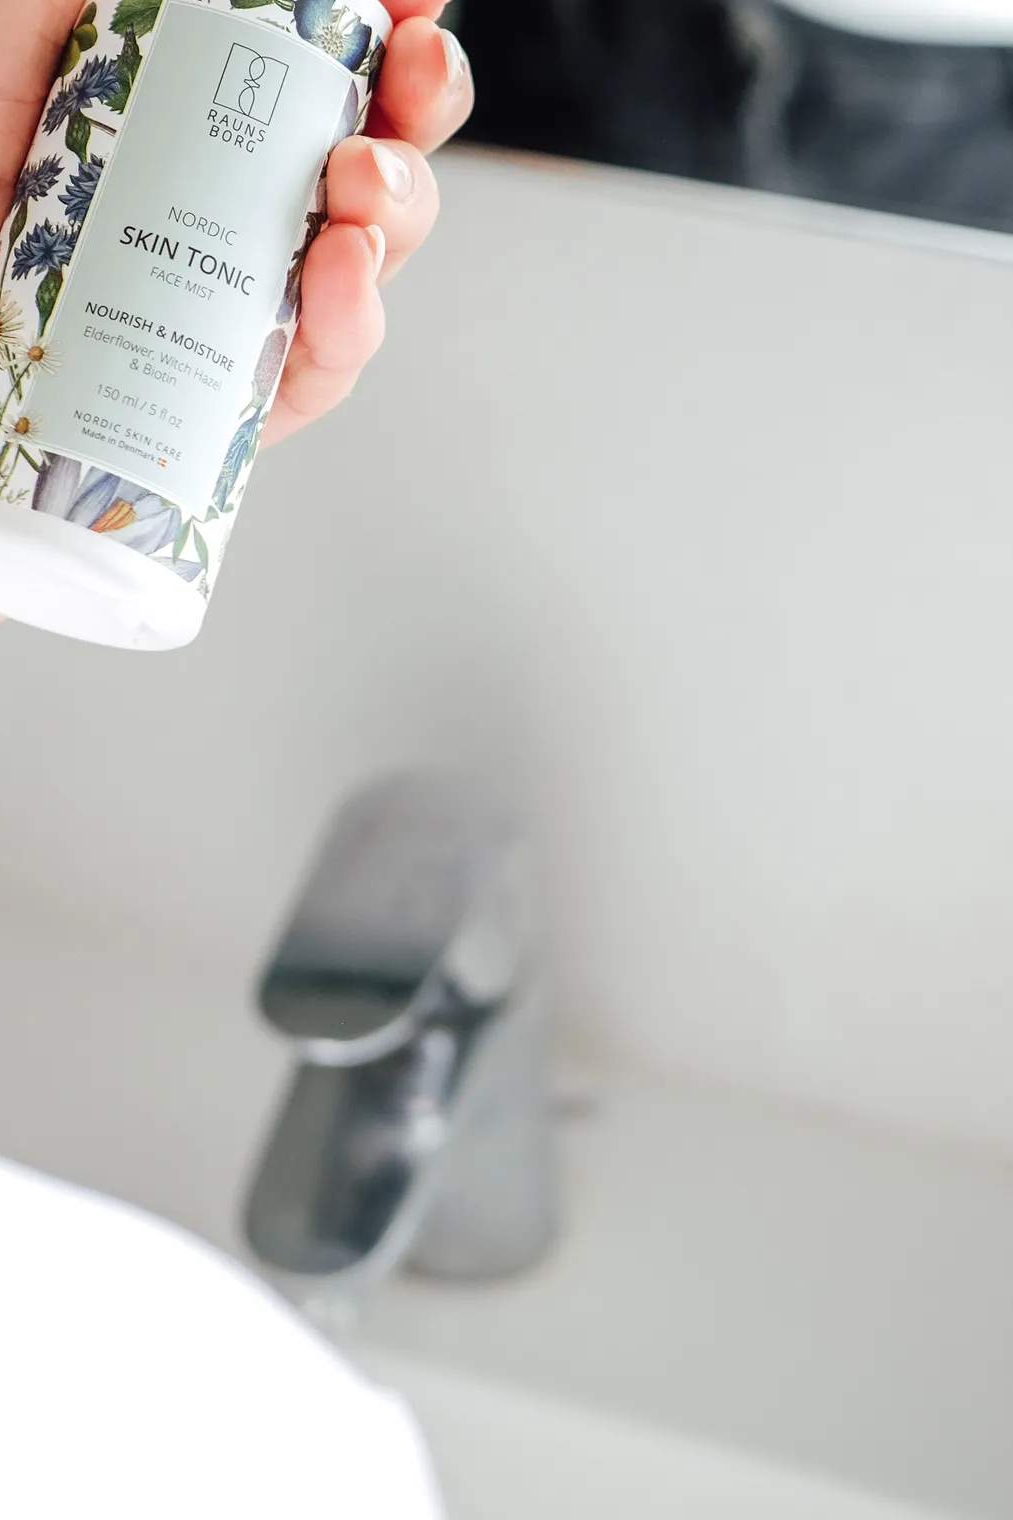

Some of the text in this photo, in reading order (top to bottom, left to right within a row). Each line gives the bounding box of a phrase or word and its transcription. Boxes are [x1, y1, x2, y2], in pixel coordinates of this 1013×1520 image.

[207, 109, 266, 142] RAUNS
[209, 124, 256, 153] BORG
[168, 206, 237, 246] NORDIC
[119, 225, 255, 296] SKIN TONIC
[150, 266, 215, 301] FACE MIST
[85, 302, 235, 372] NOURISH & MOISTURE
[83, 325, 223, 391] Elderflower, Witch Hazel
[129, 358, 177, 386] & Biotin
[97, 384, 120, 401] 150
[122, 395, 138, 409] ml
[149, 404, 157, 416] 5
[160, 408, 169, 420] fl
[170, 415, 183, 429] oz
[73, 410, 183, 461] NORDIC SKIN CARE
[81, 427, 156, 463] Made in Denmark
